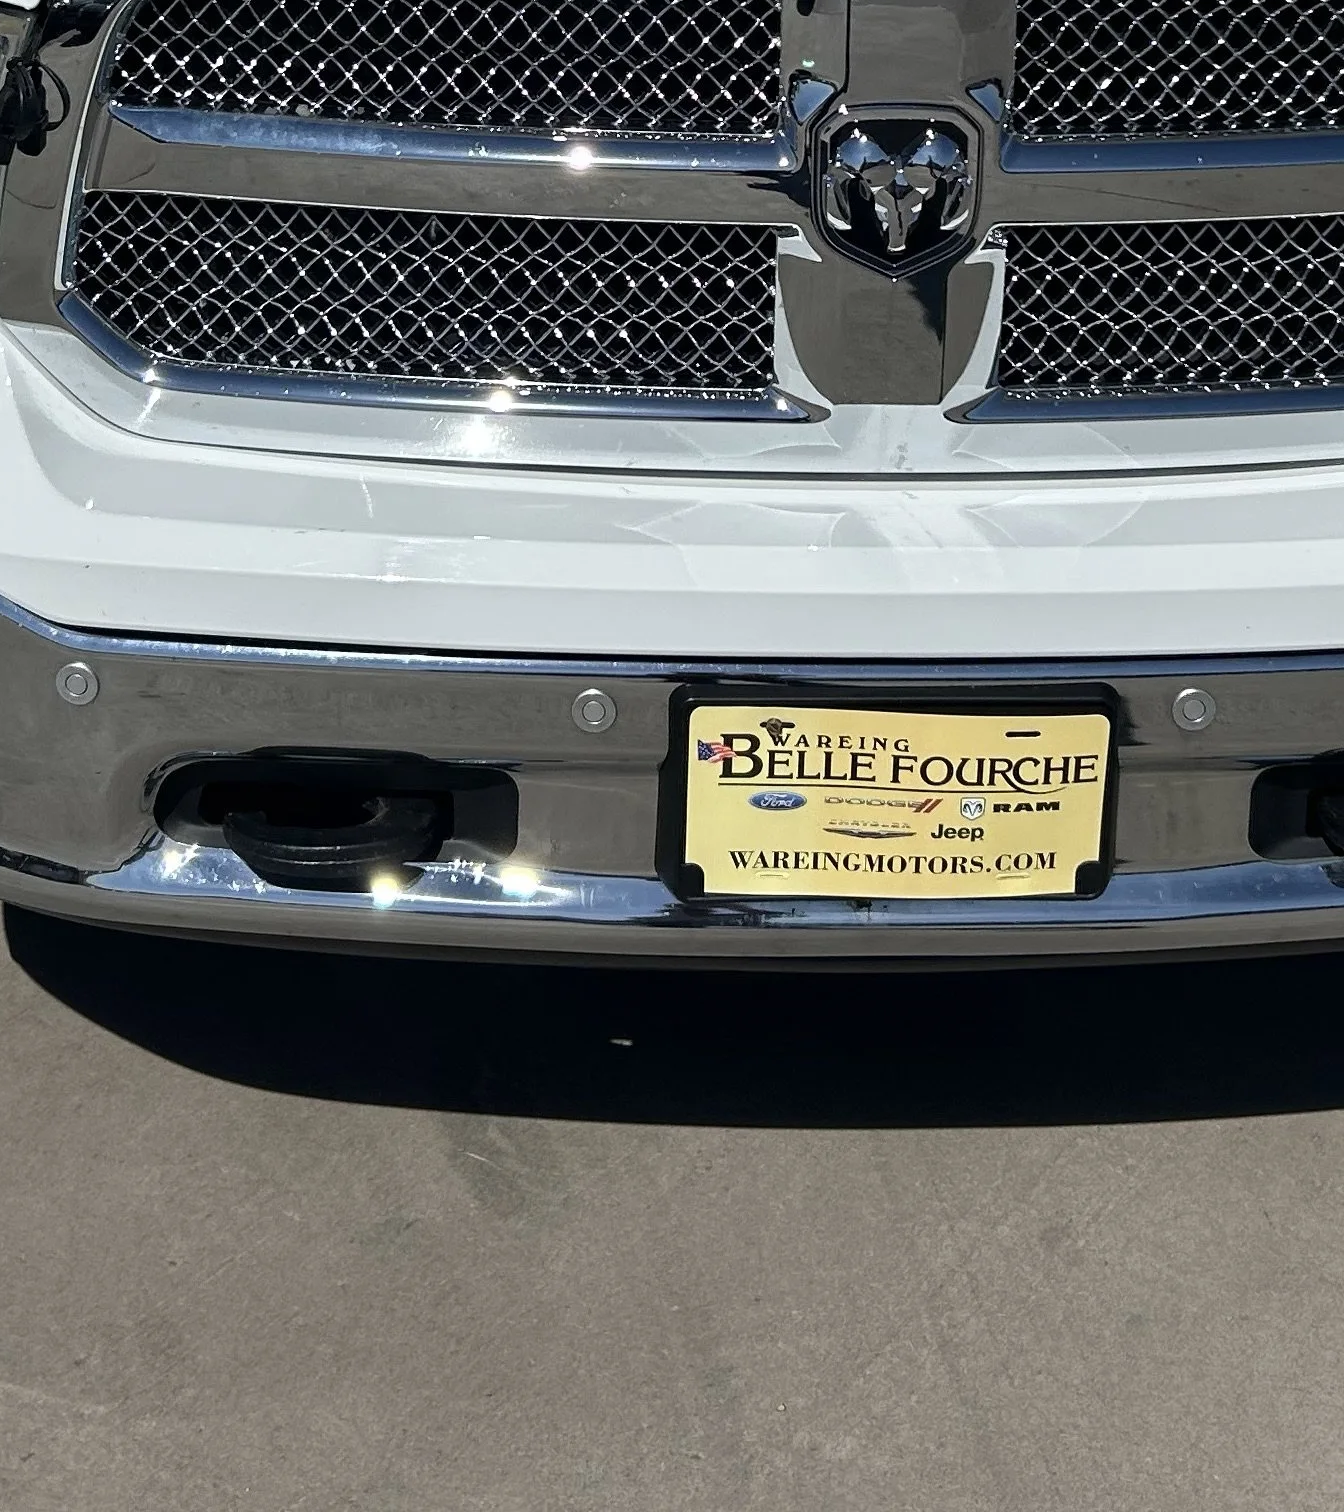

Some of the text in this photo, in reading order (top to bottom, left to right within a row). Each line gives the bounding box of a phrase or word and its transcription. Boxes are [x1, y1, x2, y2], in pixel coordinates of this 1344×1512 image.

[772, 733, 910, 753] WAREING
[718, 733, 1099, 791] BELLE FOURCHE
[824, 796, 926, 810] DODGE
[992, 800, 1061, 813] RAM
[930, 823, 985, 842] Jeep
[728, 850, 1058, 876] WAREINGMOTORS.COM
